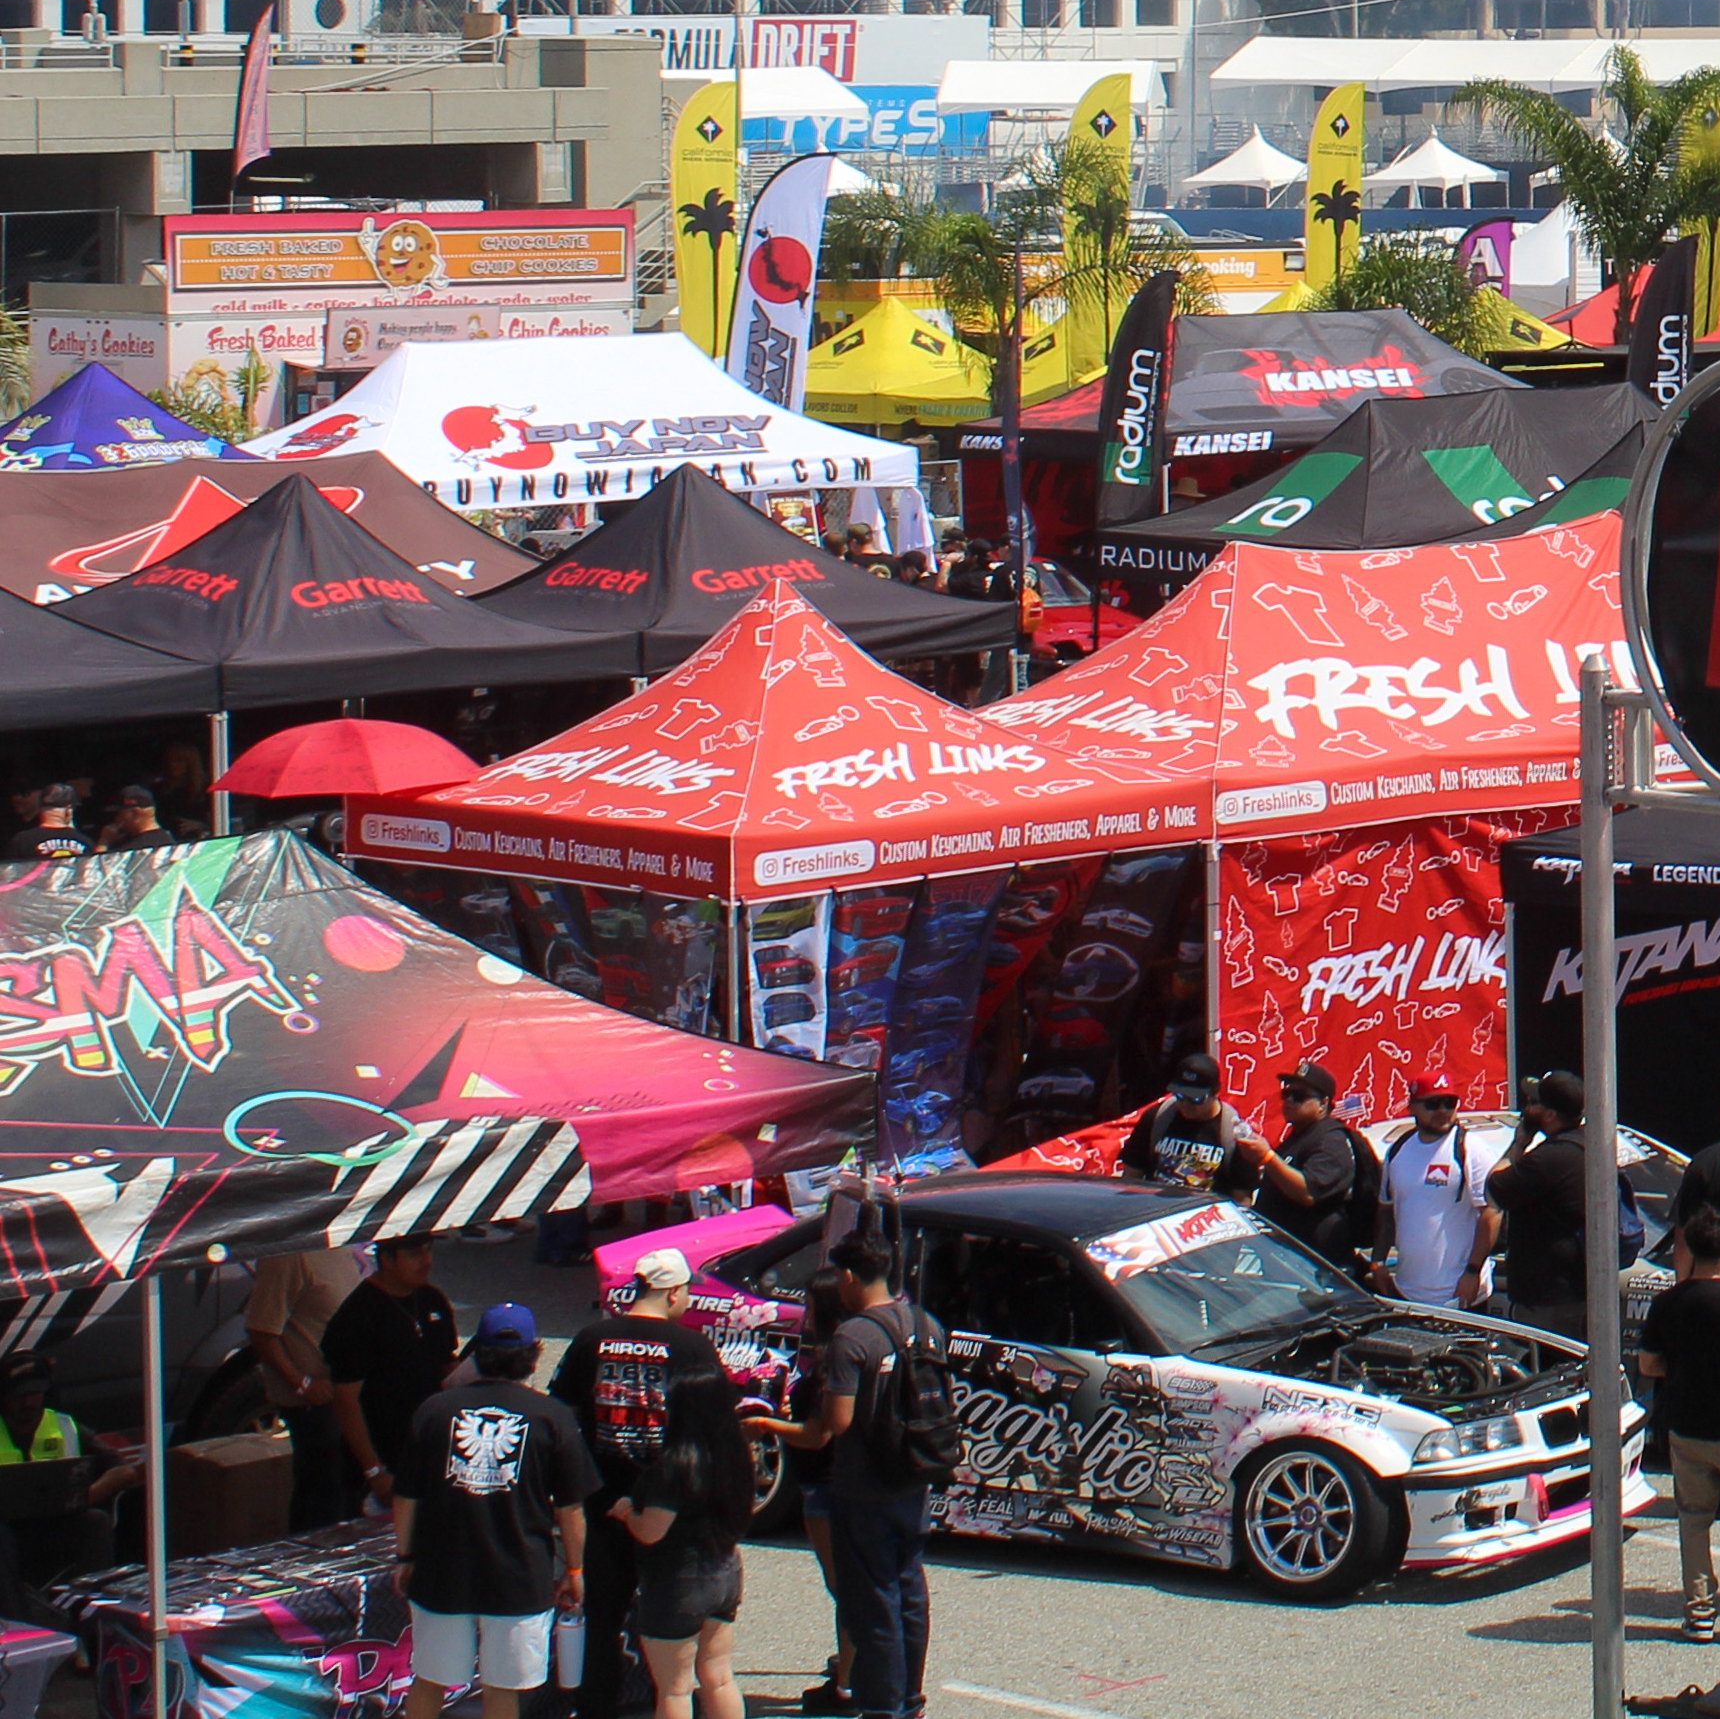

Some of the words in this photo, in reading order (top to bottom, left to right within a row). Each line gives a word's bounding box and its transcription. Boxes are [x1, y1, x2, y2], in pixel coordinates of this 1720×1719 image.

[758, 23, 853, 78] DRIFT
[776, 98, 946, 145] TYPES
[210, 240, 273, 256] FRESH
[280, 239, 343, 255] BAKED
[480, 235, 590, 251] CHOCOLATE
[219, 265, 256, 281] HOT
[262, 266, 274, 280] &
[277, 265, 334, 280] TASTY
[469, 259, 515, 275] CHIP
[519, 257, 598, 274] COOKIES
[208, 325, 255, 352] Fresh
[258, 324, 316, 351] Baked
[548, 316, 610, 337] Cookies
[48, 326, 98, 356] Cathy's
[102, 326, 155, 356] Cookies
[1265, 366, 1414, 393] KANSEI
[526, 418, 642, 444] BUY
[645, 413, 772, 437] NOW
[1113, 348, 1156, 485] radium
[577, 430, 767, 458] JAPAN
[1173, 430, 1275, 457] KANSEI
[1100, 545, 1208, 573] RADIUM
[546, 560, 650, 596] Garrett
[691, 559, 827, 594] Garrett
[290, 575, 431, 609] Garrett
[1248, 645, 1528, 738] FRESH
[588, 748, 736, 796] LINKS
[770, 741, 916, 799] FRESH
[928, 741, 1047, 775] LINKS
[1240, 789, 1321, 818] Freshlinks_
[380, 821, 445, 849] Freshlinks_
[782, 851, 867, 876] Freshlinks_
[1302, 944, 1410, 1015] FRESH
[687, 1294, 734, 1313] TIRE
[599, 1341, 669, 1358] HIROYA
[1000, 1346, 1016, 1362] 34
